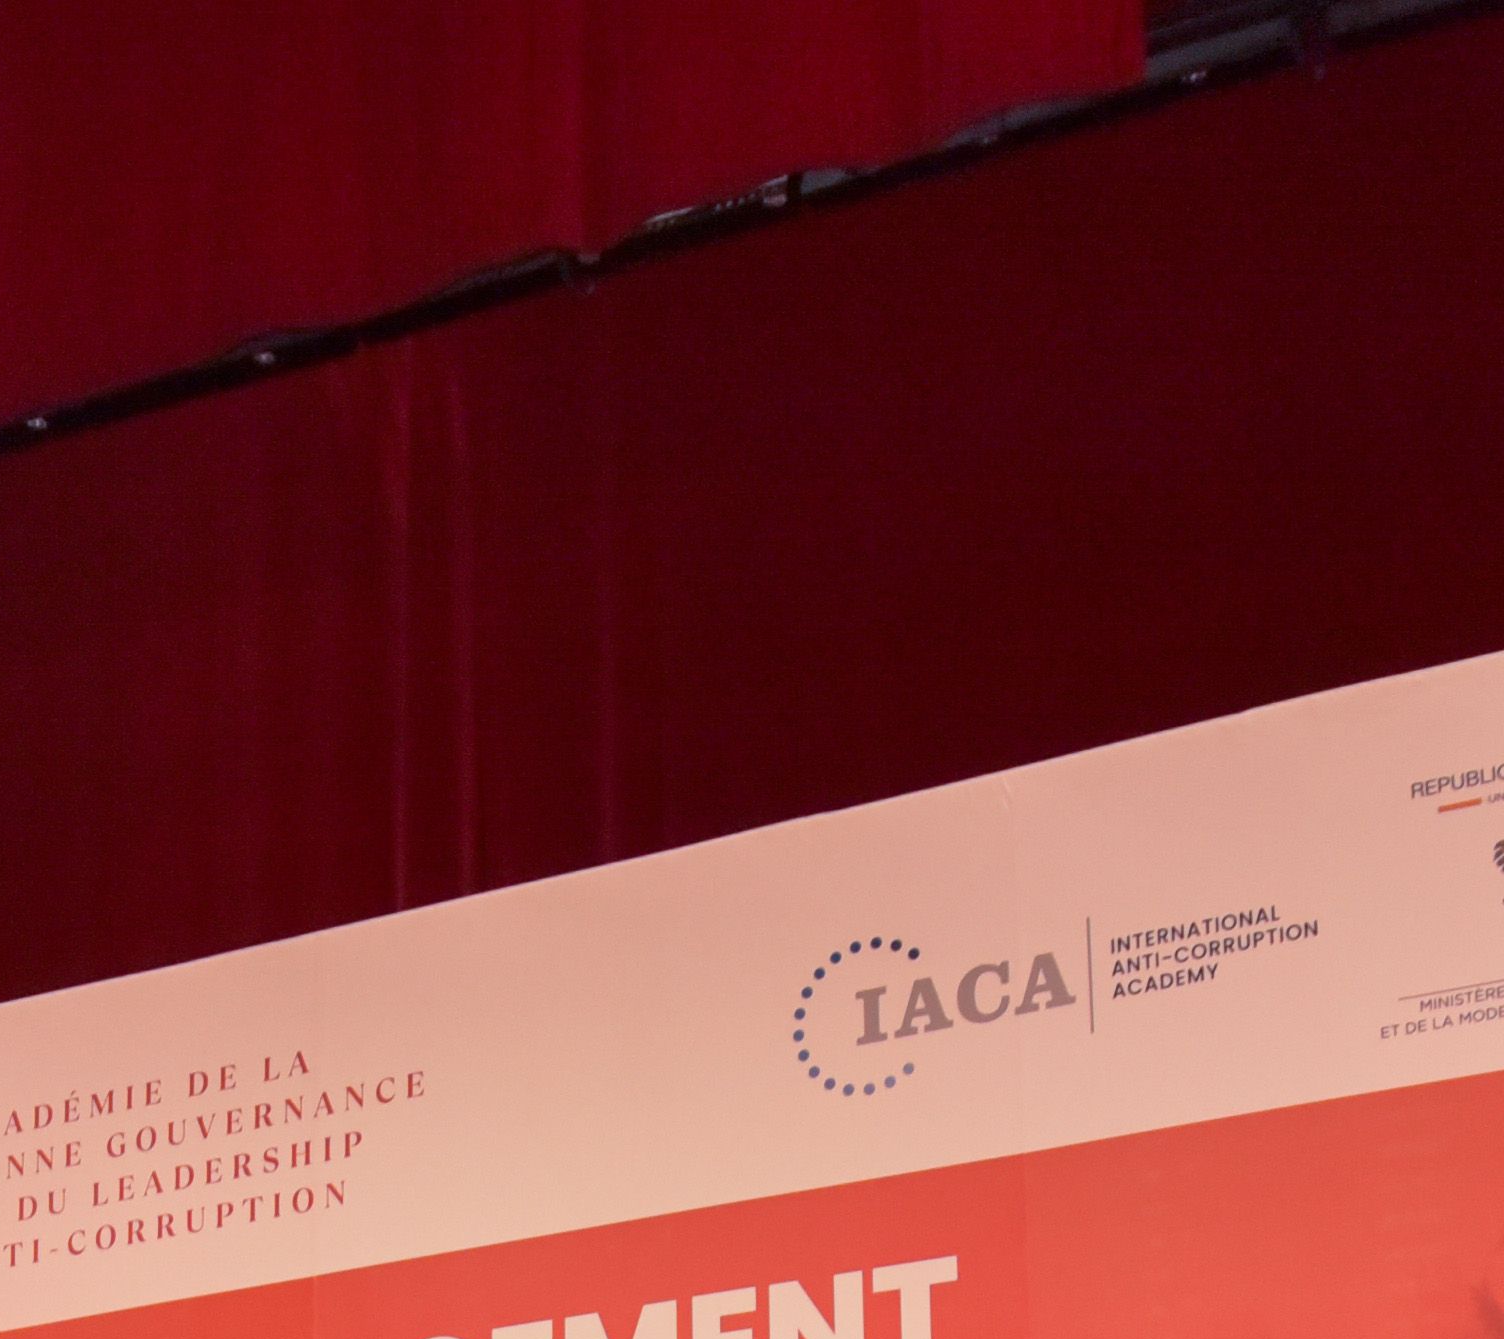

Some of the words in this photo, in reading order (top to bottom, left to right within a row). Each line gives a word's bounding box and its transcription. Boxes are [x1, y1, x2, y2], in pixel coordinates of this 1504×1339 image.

[1111, 905, 1280, 954] INTERNATIONAL
[1112, 920, 1318, 976] ANTI-CORRUPTION
[855, 952, 1076, 1046] IACA
[1113, 963, 1218, 999] ACADEMY
[1381, 1024, 1399, 1039] ET
[1405, 1019, 1427, 1035] DE
[1433, 1015, 1454, 1030] LA
[189, 1064, 236, 1097] DE
[264, 1051, 308, 1081] LA
[107, 1071, 424, 1157] GOUVERNANCE
[19, 1189, 65, 1221] DU
[93, 1132, 362, 1206] LEADERSHIP
